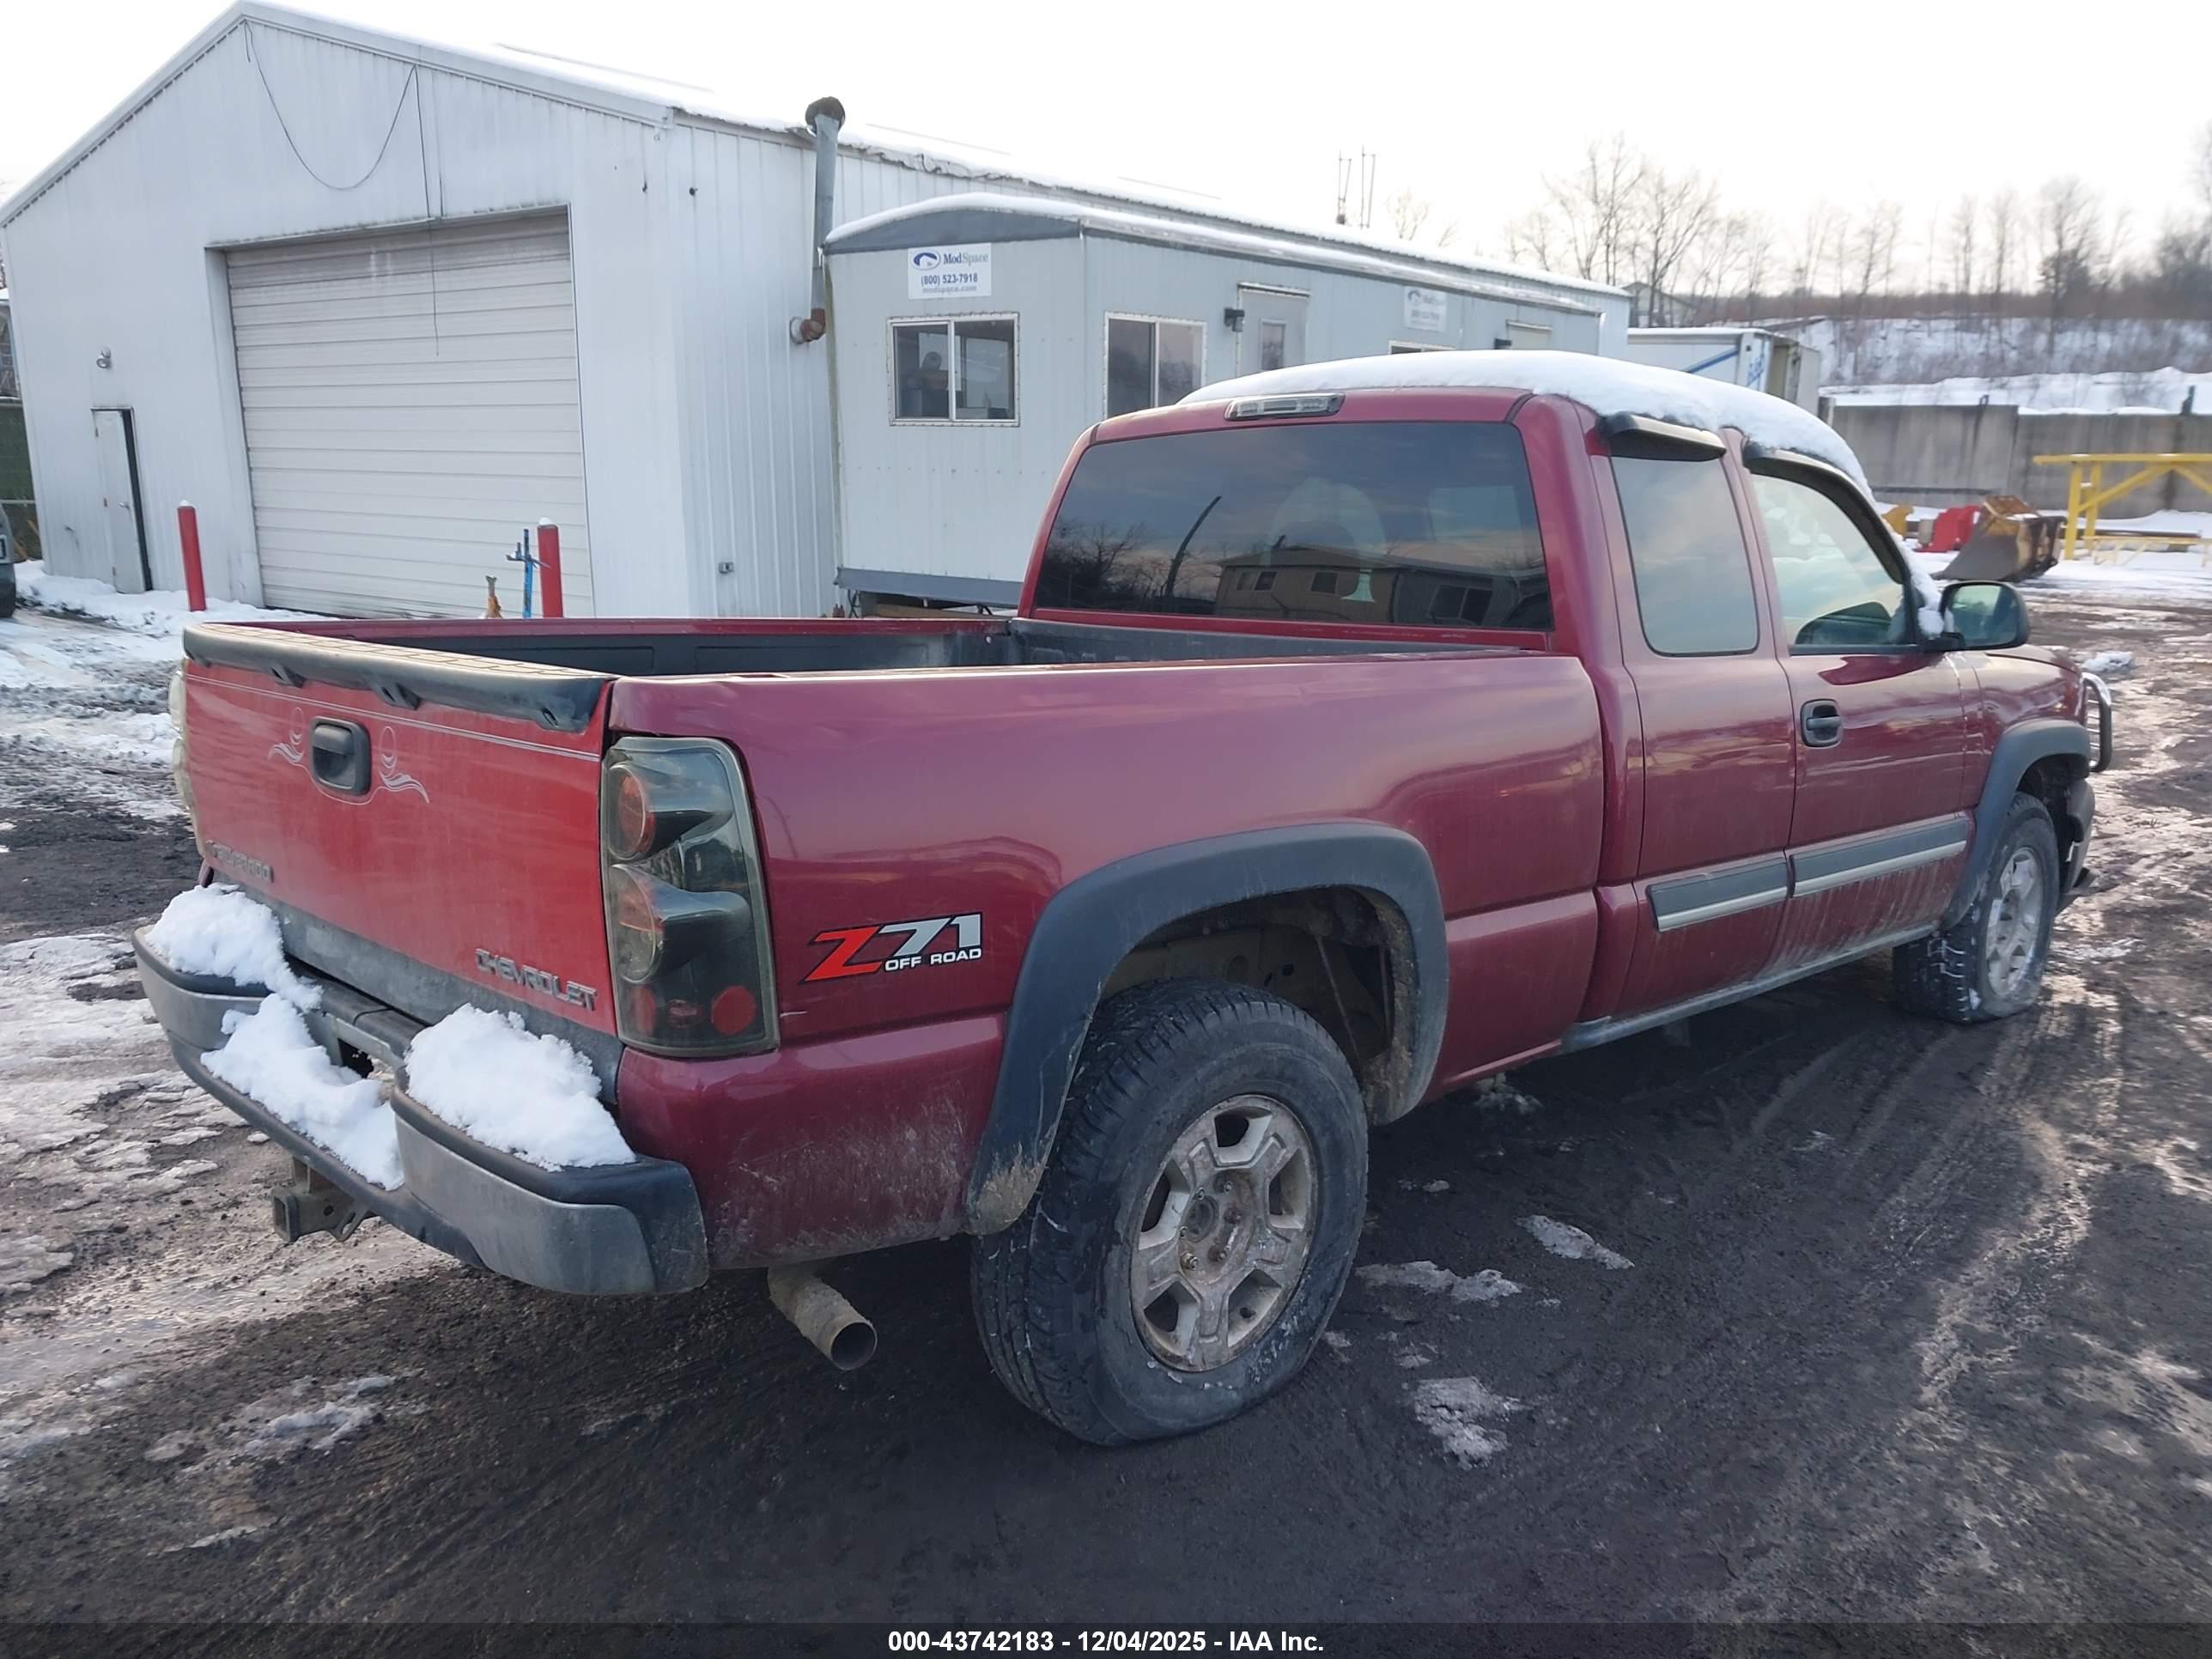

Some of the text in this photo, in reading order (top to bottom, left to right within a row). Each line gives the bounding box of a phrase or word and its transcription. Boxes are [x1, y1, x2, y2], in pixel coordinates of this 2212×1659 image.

[943, 252, 988, 266] ModSpace
[921, 272, 978, 287] (800) 523-7918
[803, 912, 982, 982] Z71
[884, 947, 982, 972] OFF ROAD
[474, 947, 599, 1012] CHEVROLET
